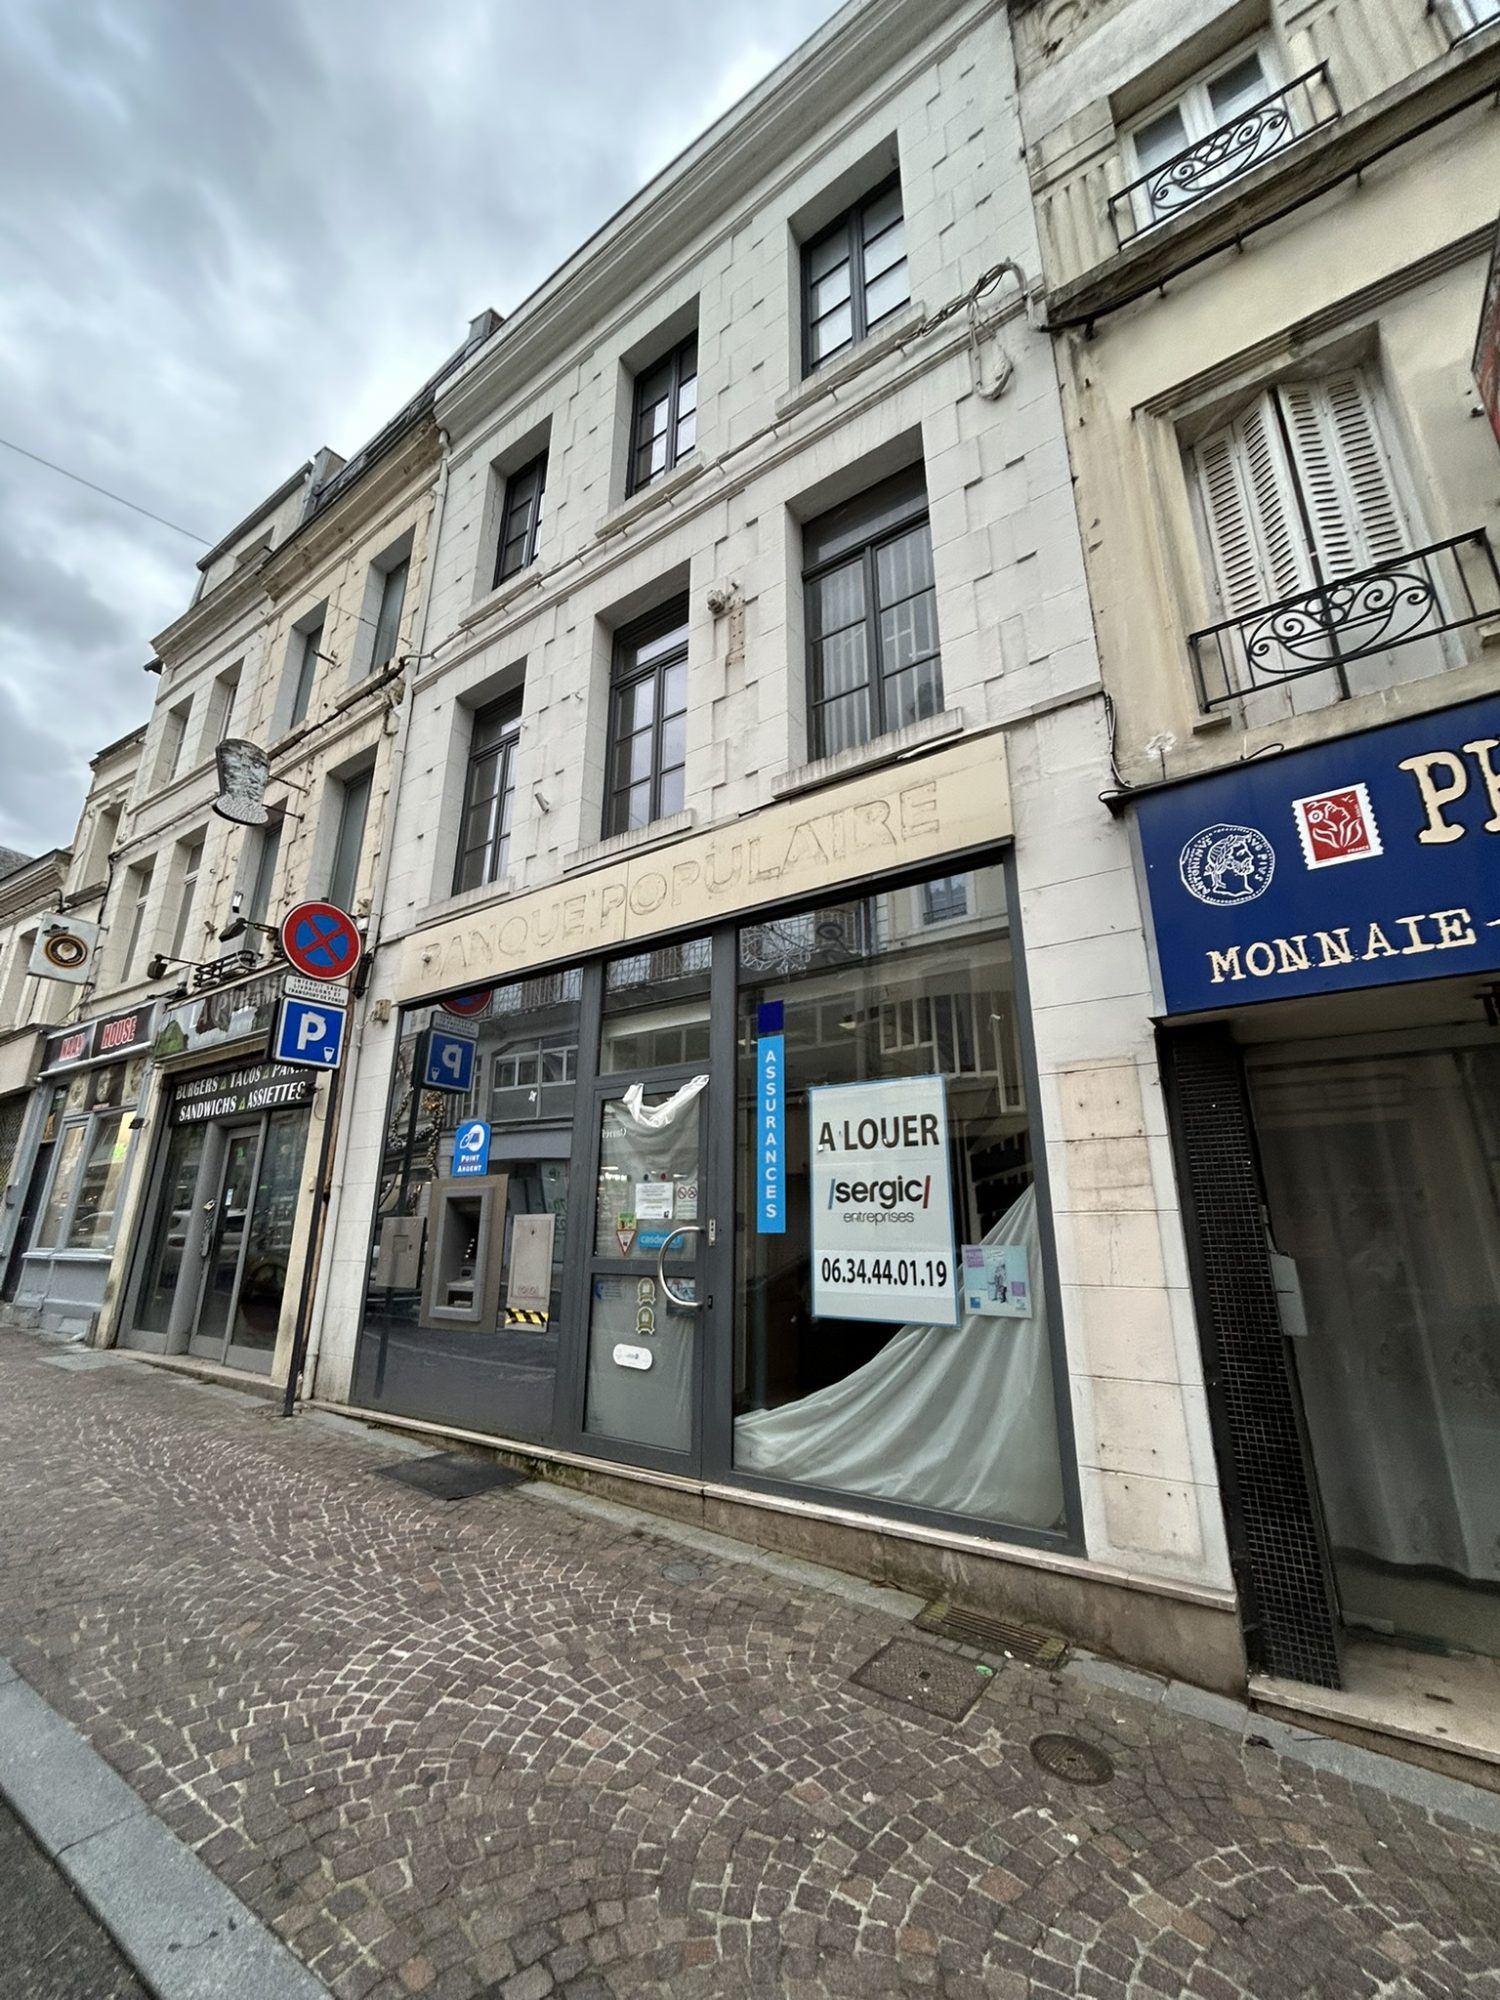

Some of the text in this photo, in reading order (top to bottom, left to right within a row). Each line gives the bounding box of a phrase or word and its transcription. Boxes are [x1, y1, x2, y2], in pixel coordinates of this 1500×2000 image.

[600, 780, 940, 930] POPULAIRE
[1205, 908, 1477, 984] MONNAIE
[101, 1015, 138, 1050] HOUSE
[297, 1011, 327, 1050] P
[175, 1075, 218, 1100] BURGERS
[230, 1065, 263, 1088] TACOS
[179, 1081, 306, 1122] SANDWICHS ASSIETTES
[765, 1049, 777, 1219] ASSURANCES
[818, 1113, 940, 1151] A LOUER
[843, 1211, 915, 1226] entreprises
[821, 1257, 947, 1287] 06.34.44.01.19
